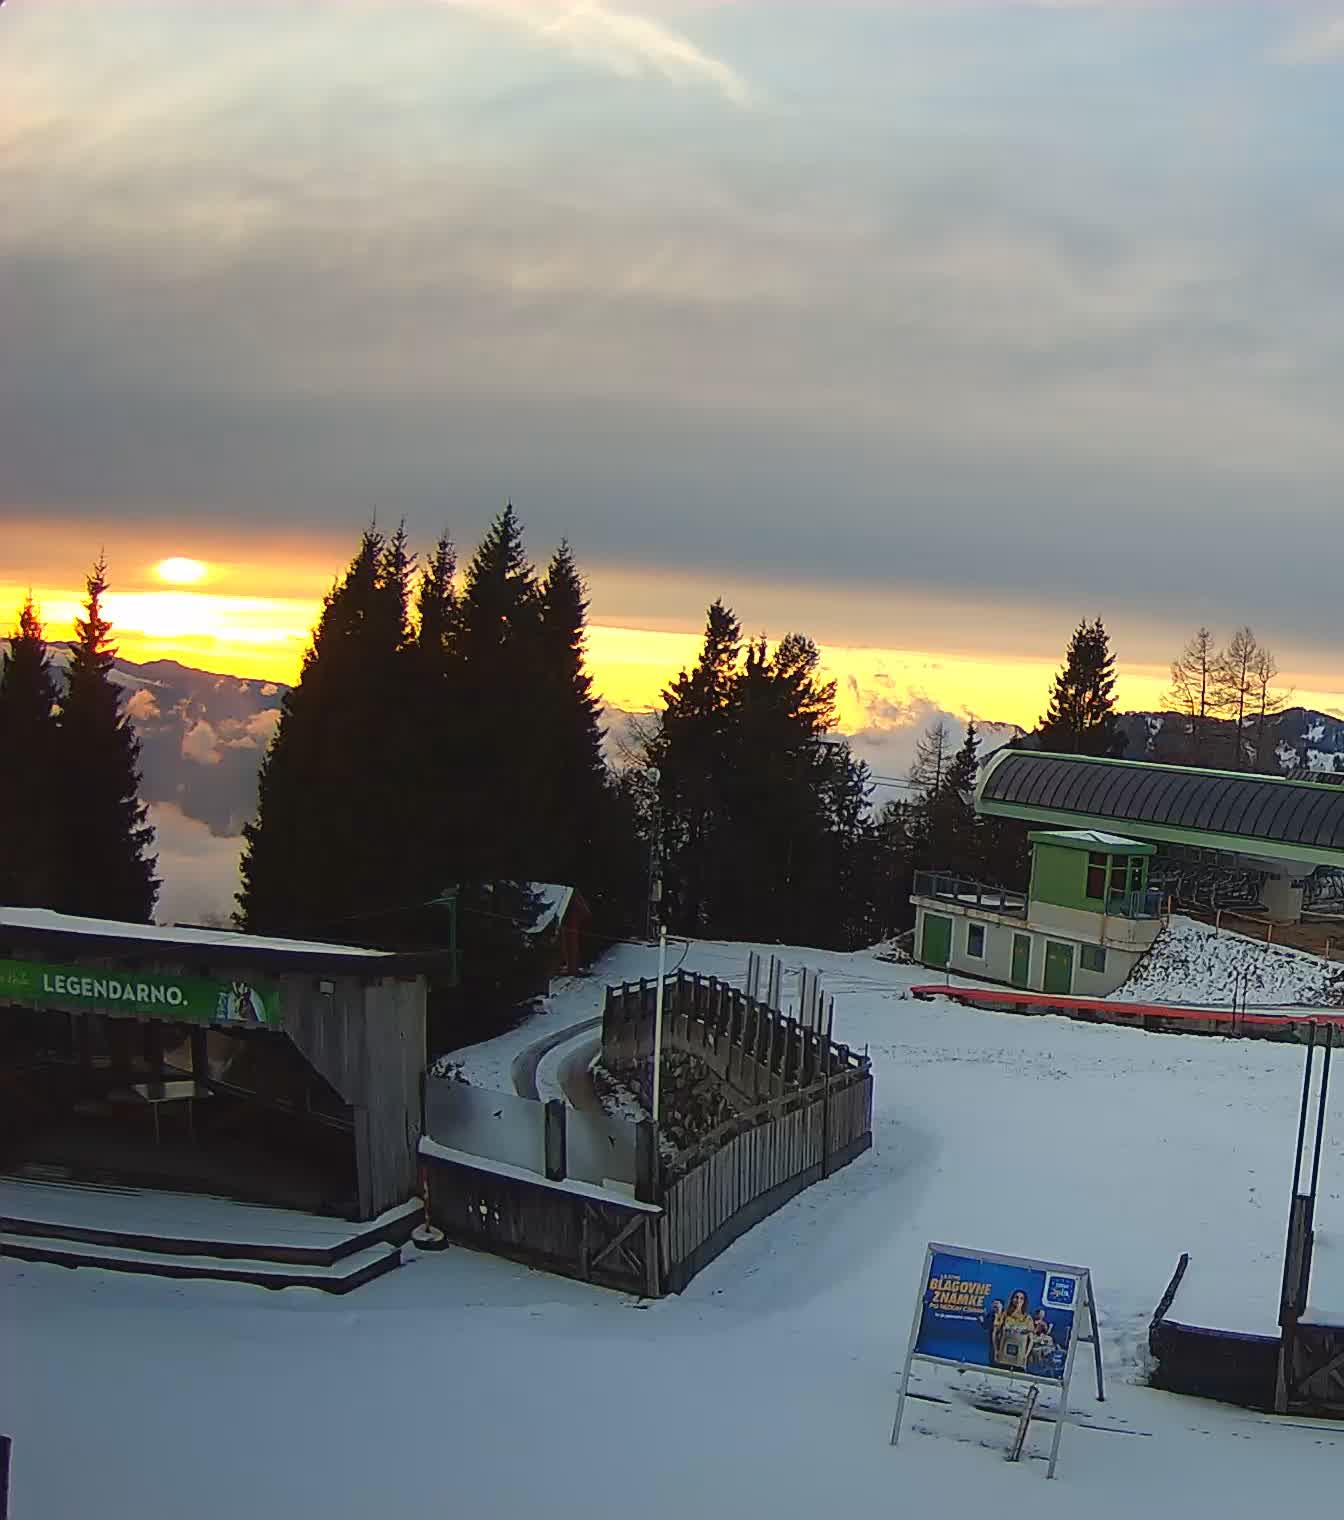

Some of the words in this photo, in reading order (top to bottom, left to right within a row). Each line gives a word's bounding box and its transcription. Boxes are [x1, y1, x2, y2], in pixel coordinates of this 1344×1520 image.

[42, 973, 189, 1006] LEGENDARNO.
[929, 1278, 992, 1296] BLAGOVNE
[932, 1291, 985, 1307] ZNAMKE
